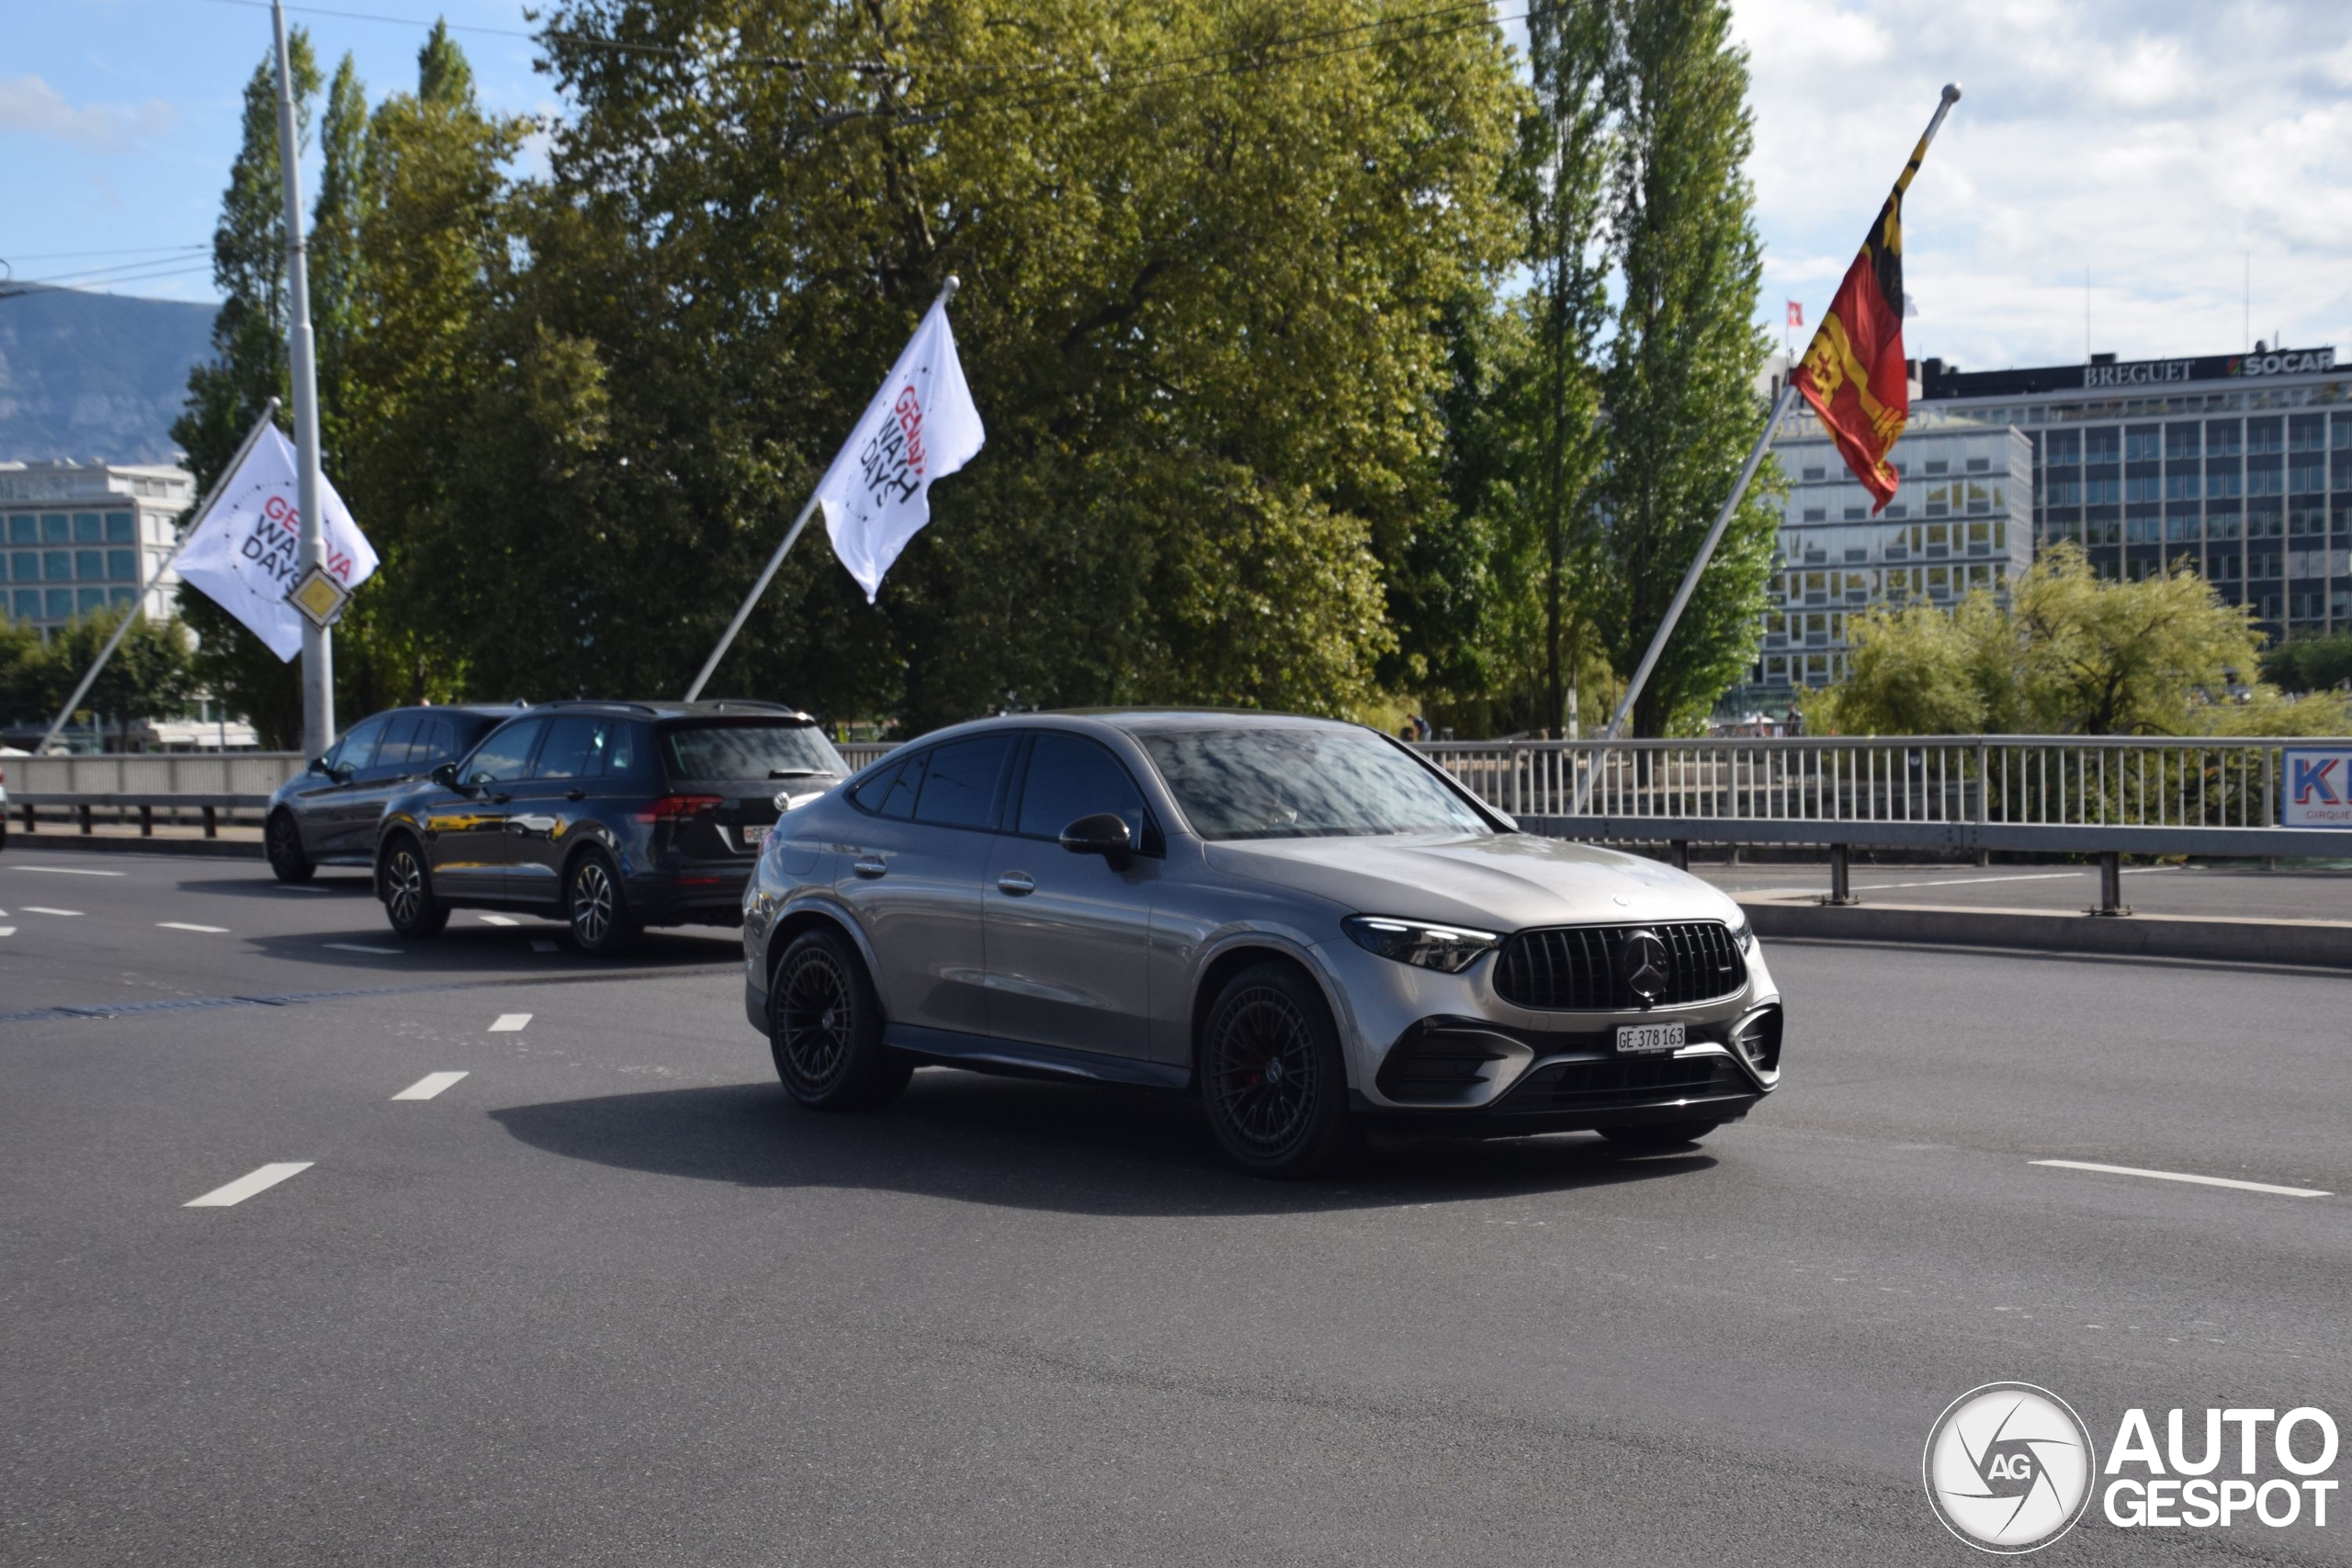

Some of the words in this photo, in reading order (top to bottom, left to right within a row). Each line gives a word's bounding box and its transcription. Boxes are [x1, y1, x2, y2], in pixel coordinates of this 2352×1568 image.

[2083, 359, 2195, 387] BREGUET
[2245, 352, 2335, 376] SOCAR
[265, 495, 353, 582] GEVA
[2294, 758, 2352, 806] K
